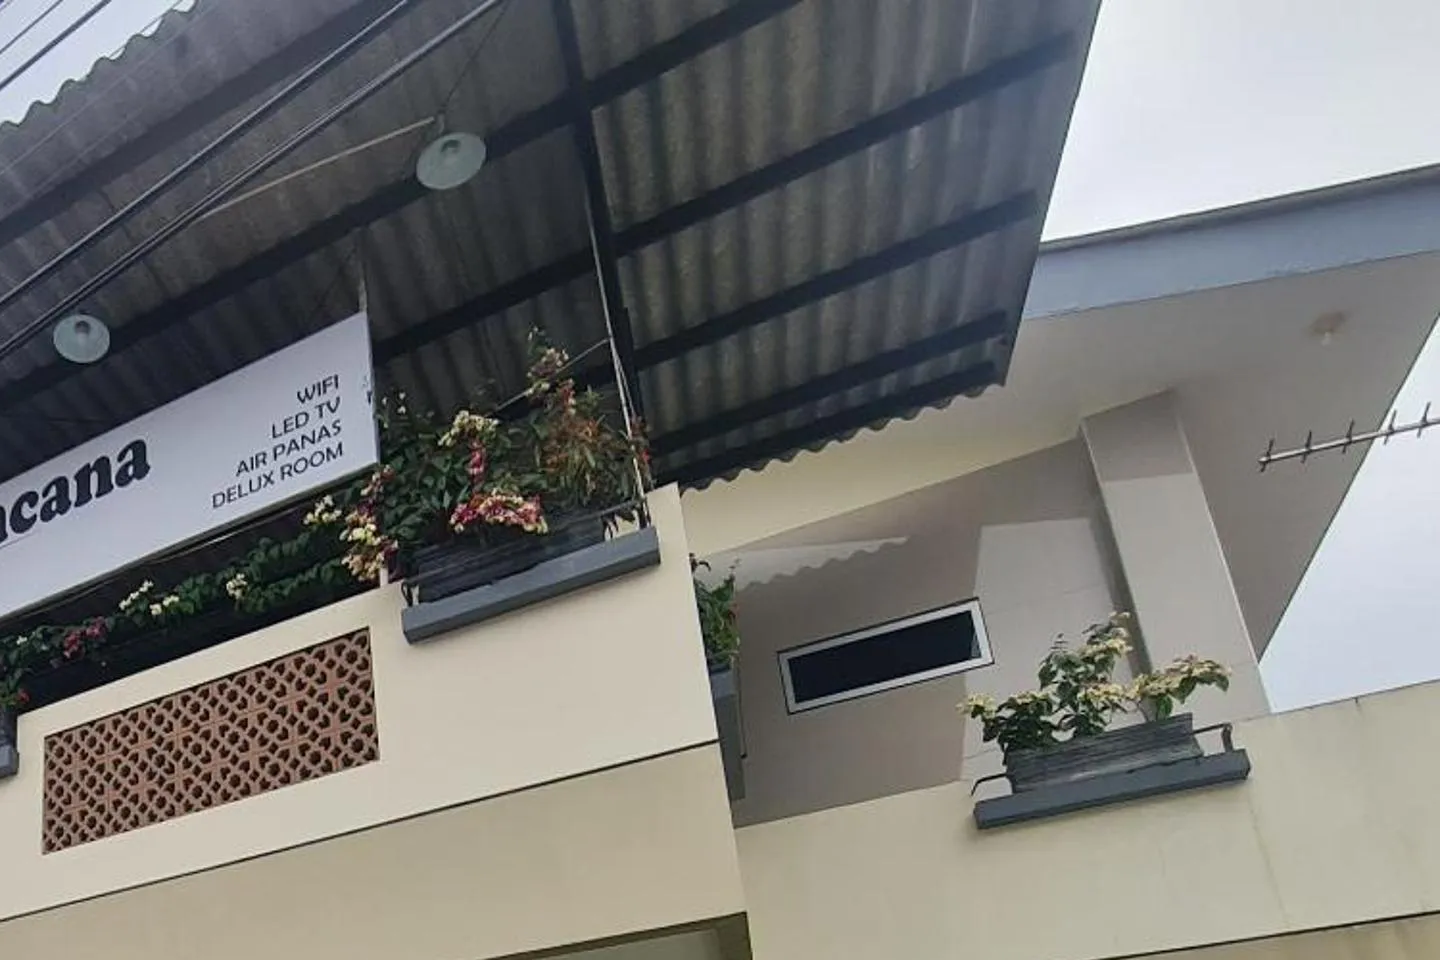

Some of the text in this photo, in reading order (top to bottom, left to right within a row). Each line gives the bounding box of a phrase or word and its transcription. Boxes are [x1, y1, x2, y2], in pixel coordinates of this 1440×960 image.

[296, 373, 339, 405] WIFI
[271, 396, 341, 440] LED TV
[235, 418, 342, 478] AIR PANAS
[211, 440, 344, 510] DELUX ROOM
